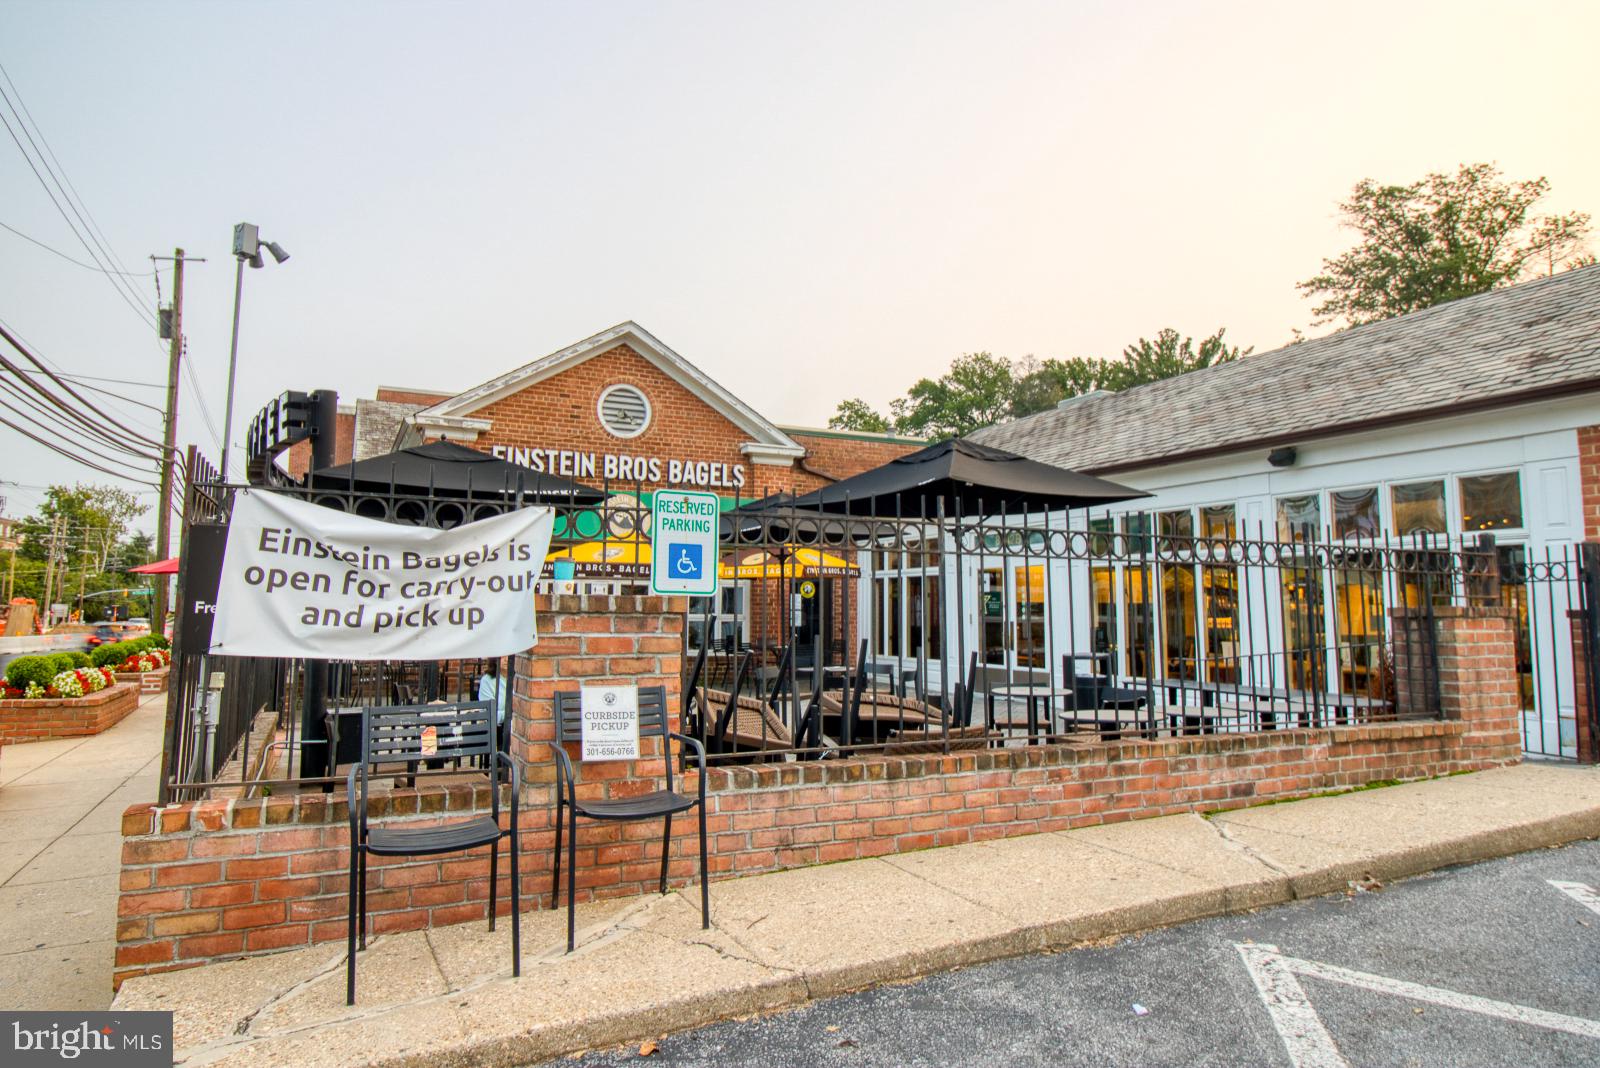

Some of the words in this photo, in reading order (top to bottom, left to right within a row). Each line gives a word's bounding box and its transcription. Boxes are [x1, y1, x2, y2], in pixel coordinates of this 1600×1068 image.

[492, 445, 596, 479] EINSTEIN
[604, 454, 661, 482] BROS
[668, 459, 746, 488] BAGELS
[658, 500, 714, 516] RESERVED
[661, 518, 710, 533] PARKING
[258, 526, 391, 571] Einstein
[401, 542, 500, 573] Bagels
[509, 538, 532, 562] is
[243, 564, 331, 593] open
[343, 569, 391, 600] for
[400, 571, 535, 600] carry-out
[301, 605, 364, 629] and
[373, 604, 439, 633] pick
[448, 606, 486, 630] up
[584, 711, 636, 720] CURBSIDE
[591, 721, 630, 731] PICKUP
[586, 747, 635, 756] 301-656-0766
